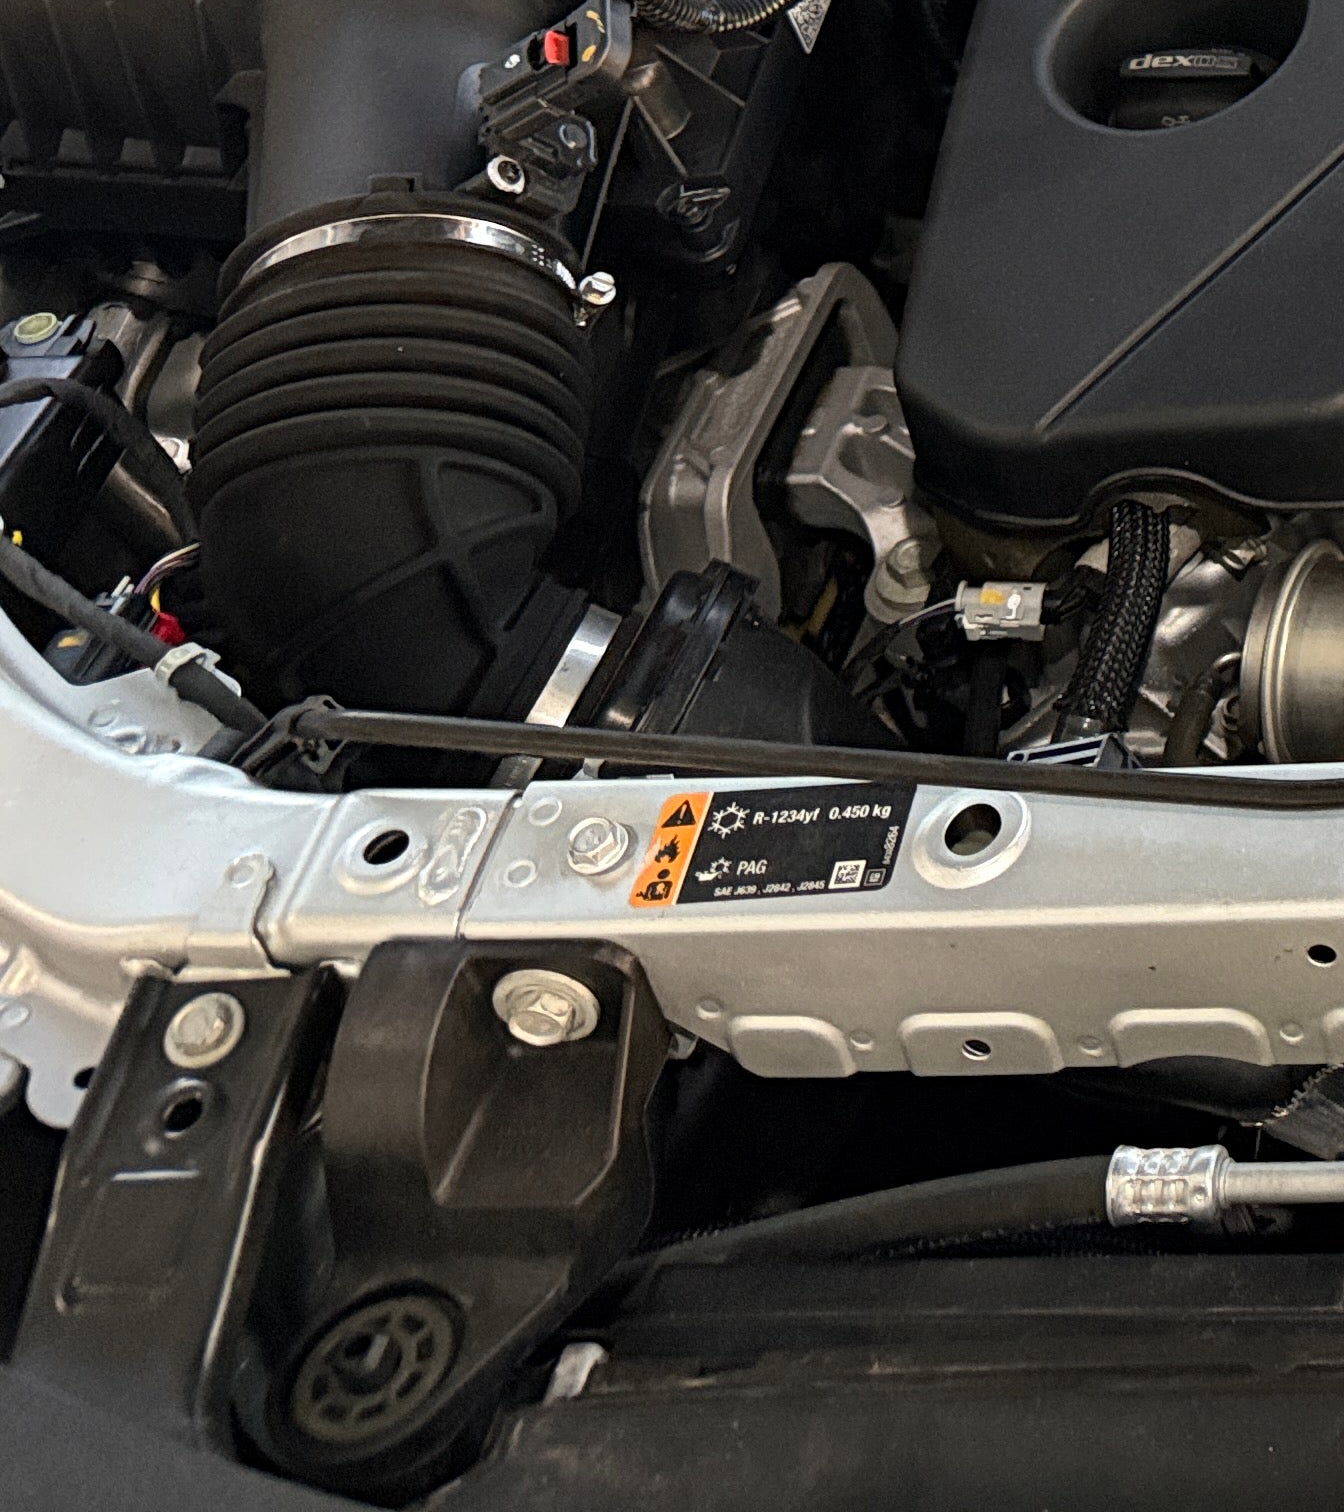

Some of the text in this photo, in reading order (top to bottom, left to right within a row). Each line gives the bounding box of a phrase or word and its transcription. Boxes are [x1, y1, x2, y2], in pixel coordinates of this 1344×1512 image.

[1128, 53, 1239, 70] dexos
[752, 804, 892, 826] R-1234yf 0.450 kg
[736, 859, 769, 876] PAG
[713, 886, 733, 897] SAE
